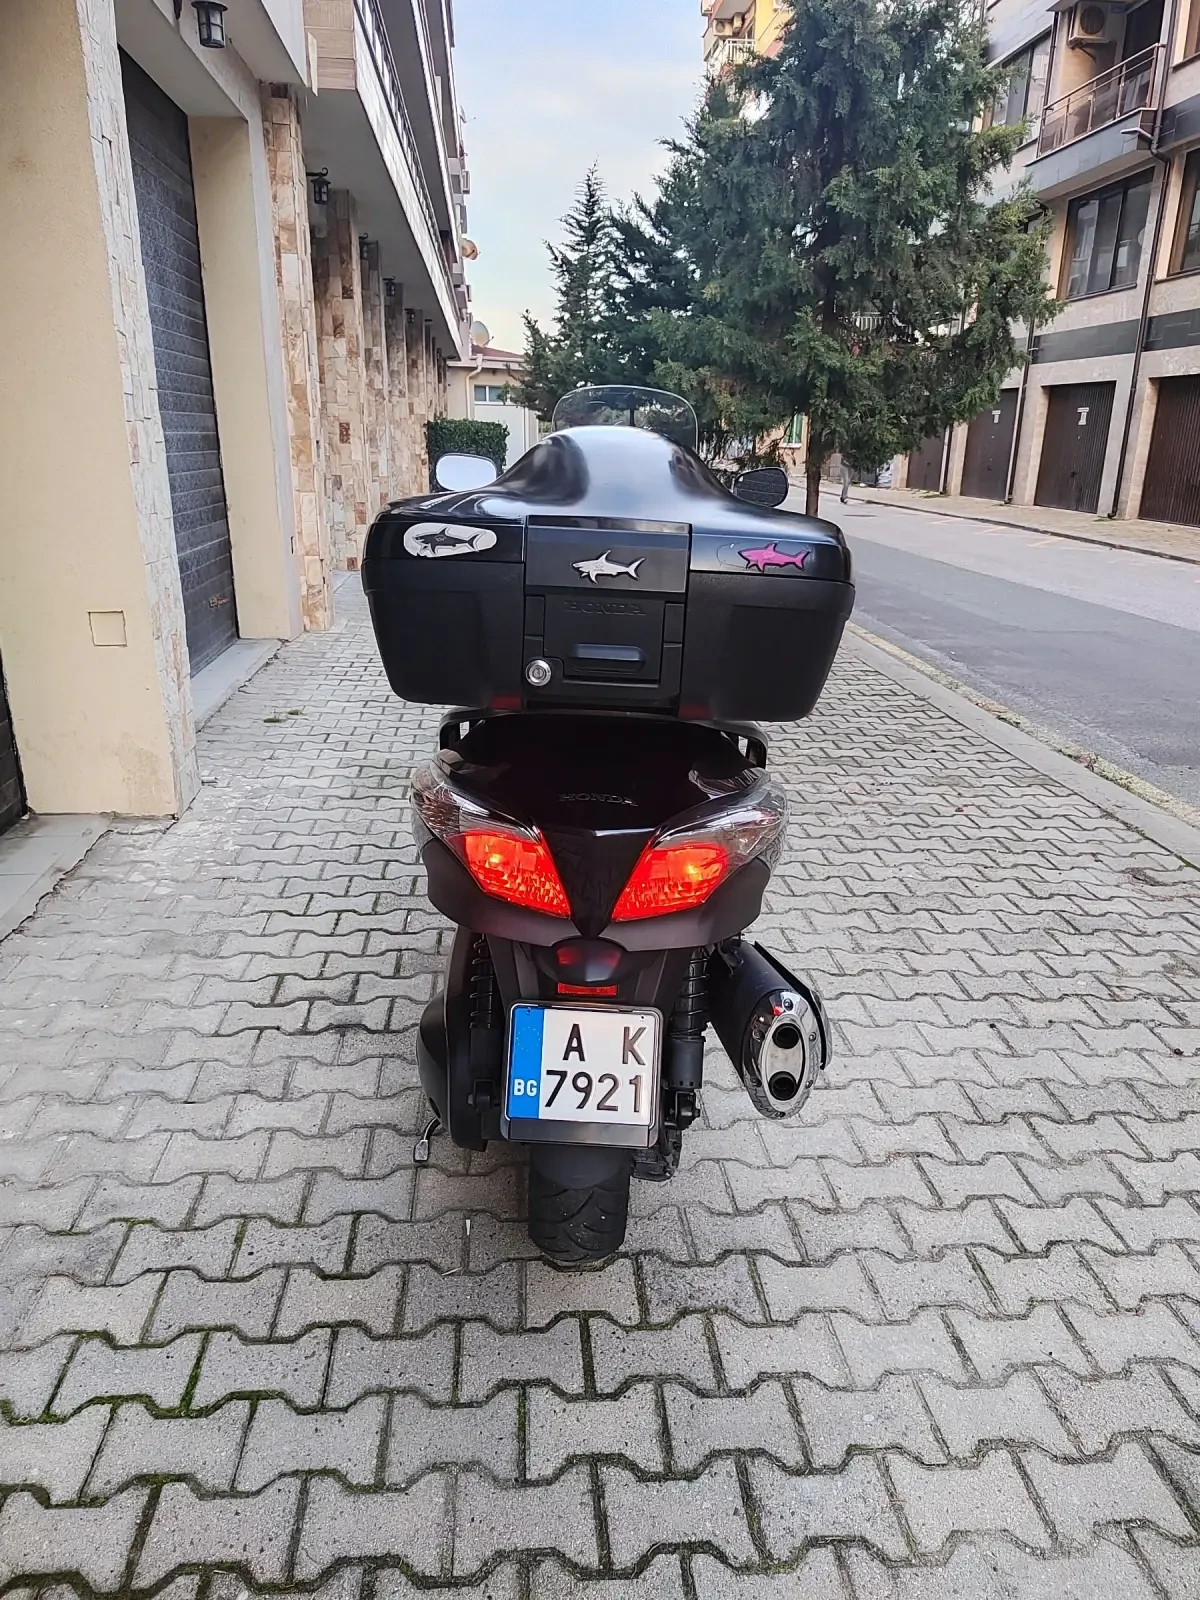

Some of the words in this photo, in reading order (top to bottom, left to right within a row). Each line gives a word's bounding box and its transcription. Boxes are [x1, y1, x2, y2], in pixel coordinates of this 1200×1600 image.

[563, 601, 646, 615] HONDA
[559, 793, 639, 807] HONDA
[513, 1078, 538, 1097] BG
[544, 1069, 643, 1113] 7921
